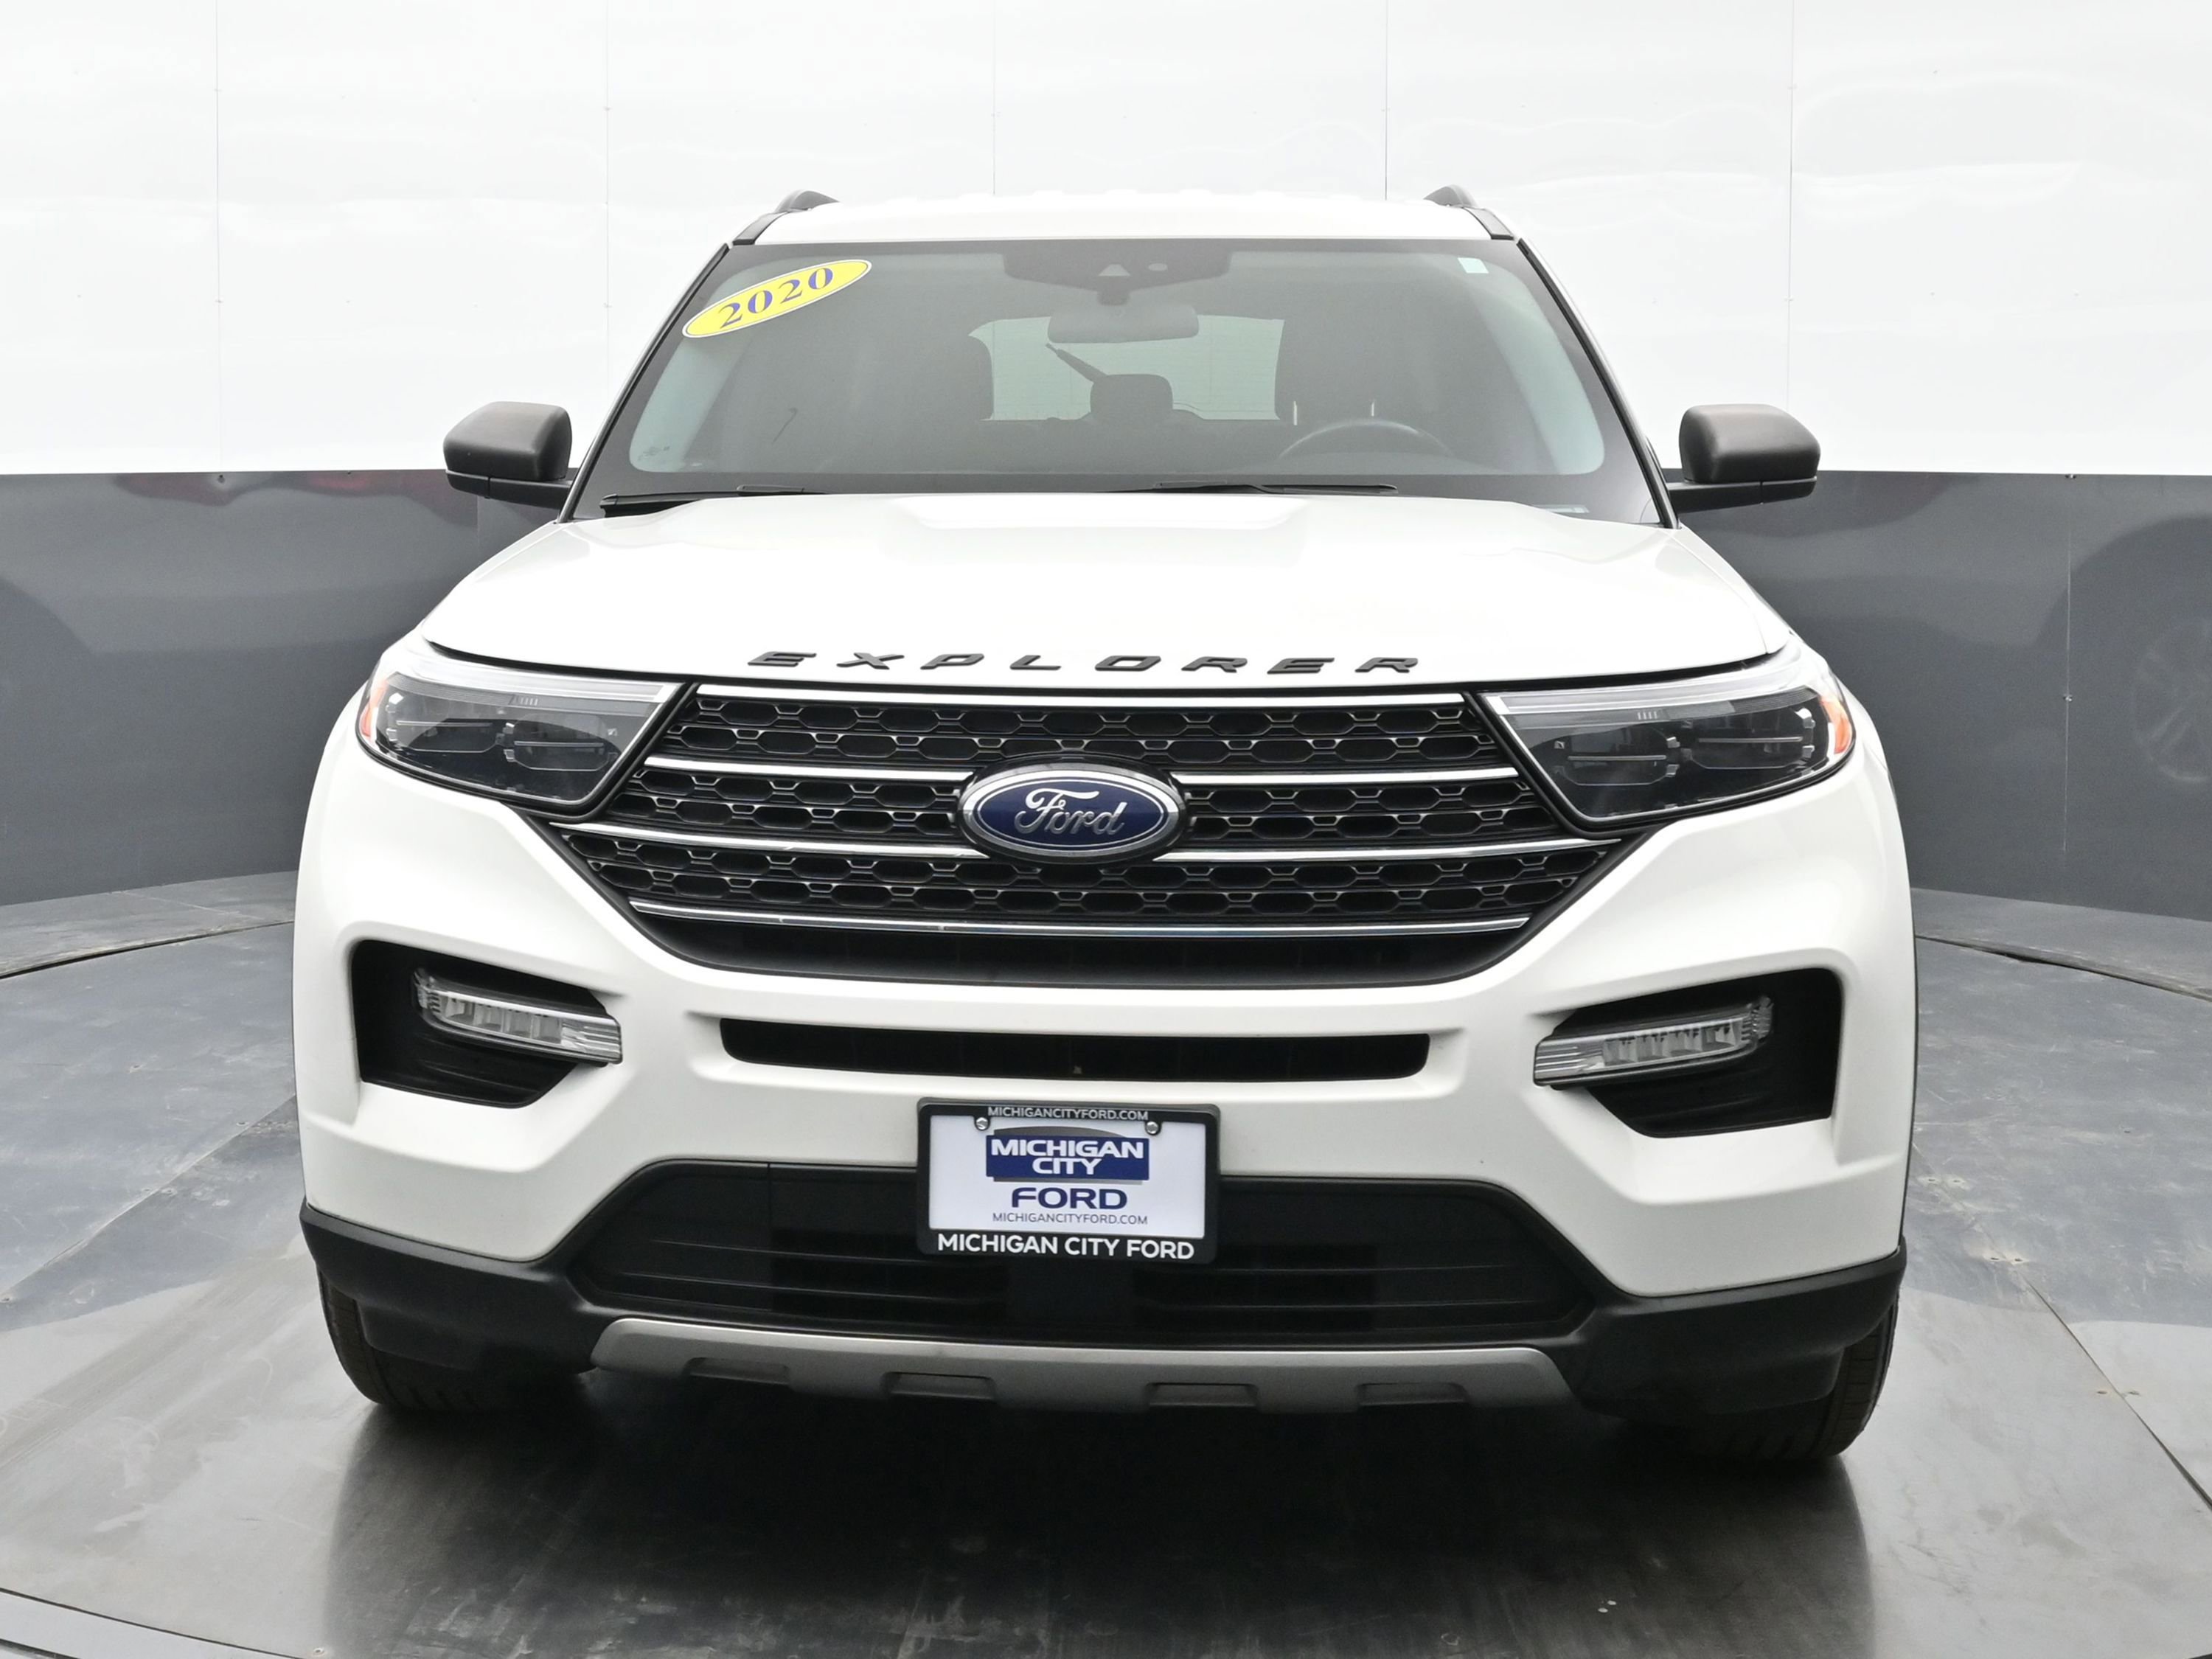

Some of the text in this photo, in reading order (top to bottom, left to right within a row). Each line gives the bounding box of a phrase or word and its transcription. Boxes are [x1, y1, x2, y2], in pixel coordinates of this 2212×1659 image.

[718, 268, 833, 329] 2020
[748, 651, 1418, 674] EXPLORER
[1014, 787, 1127, 835] Ford
[988, 1106, 1149, 1121] MICHIGANCITYFORD.COM
[991, 1138, 1144, 1159] MICHIGAN
[1032, 1158, 1102, 1175] CITY
[1012, 1187, 1128, 1209] FORD
[992, 1211, 1148, 1225] MICHIGANCITYFORD.COM
[938, 1233, 1194, 1259] MICHIGAN CITY FORD
